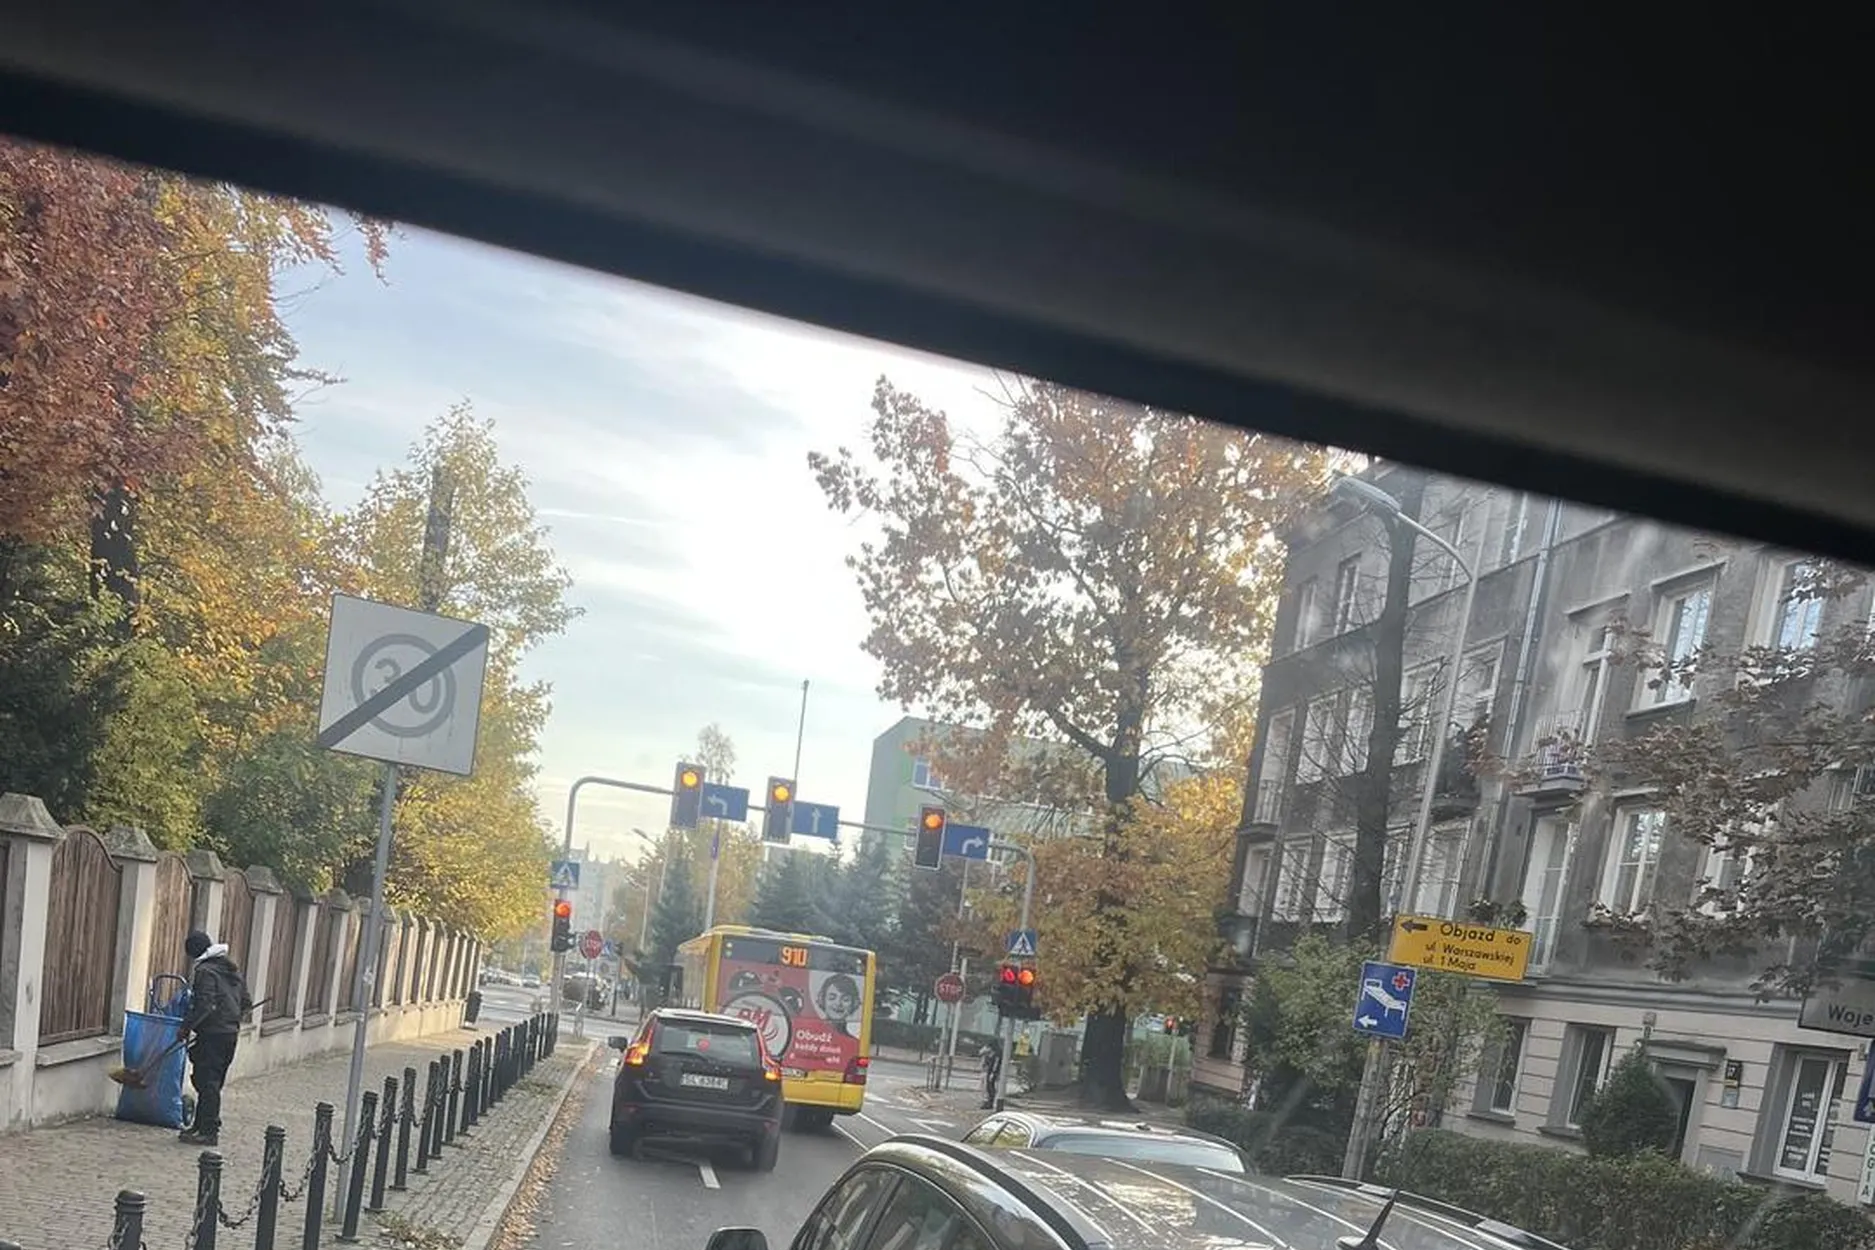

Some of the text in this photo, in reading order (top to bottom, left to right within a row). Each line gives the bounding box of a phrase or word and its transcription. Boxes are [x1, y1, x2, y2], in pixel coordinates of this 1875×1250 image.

[1440, 922, 1521, 945] Objazd do
[1443, 943, 1515, 966] Warszawskiej
[1448, 957, 1477, 971] Maja
[939, 982, 963, 994] STOP
